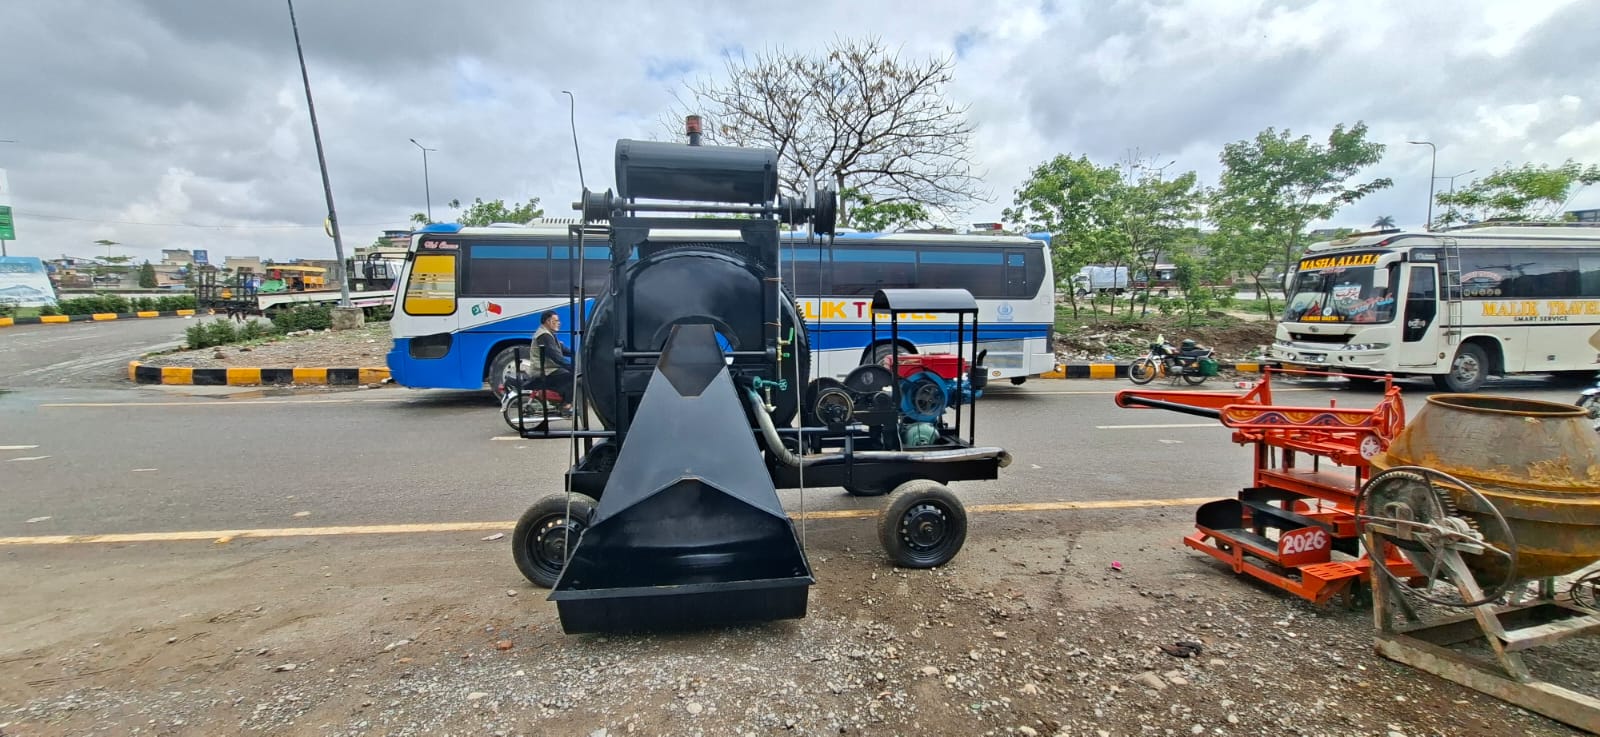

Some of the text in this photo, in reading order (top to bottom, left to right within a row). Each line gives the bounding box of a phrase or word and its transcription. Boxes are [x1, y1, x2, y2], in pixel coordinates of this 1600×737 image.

[1301, 257, 1336, 270] MASHA
[803, 301, 847, 319] LIK
[1482, 301, 1538, 316] MALIK
[1282, 530, 1327, 555] 2026
